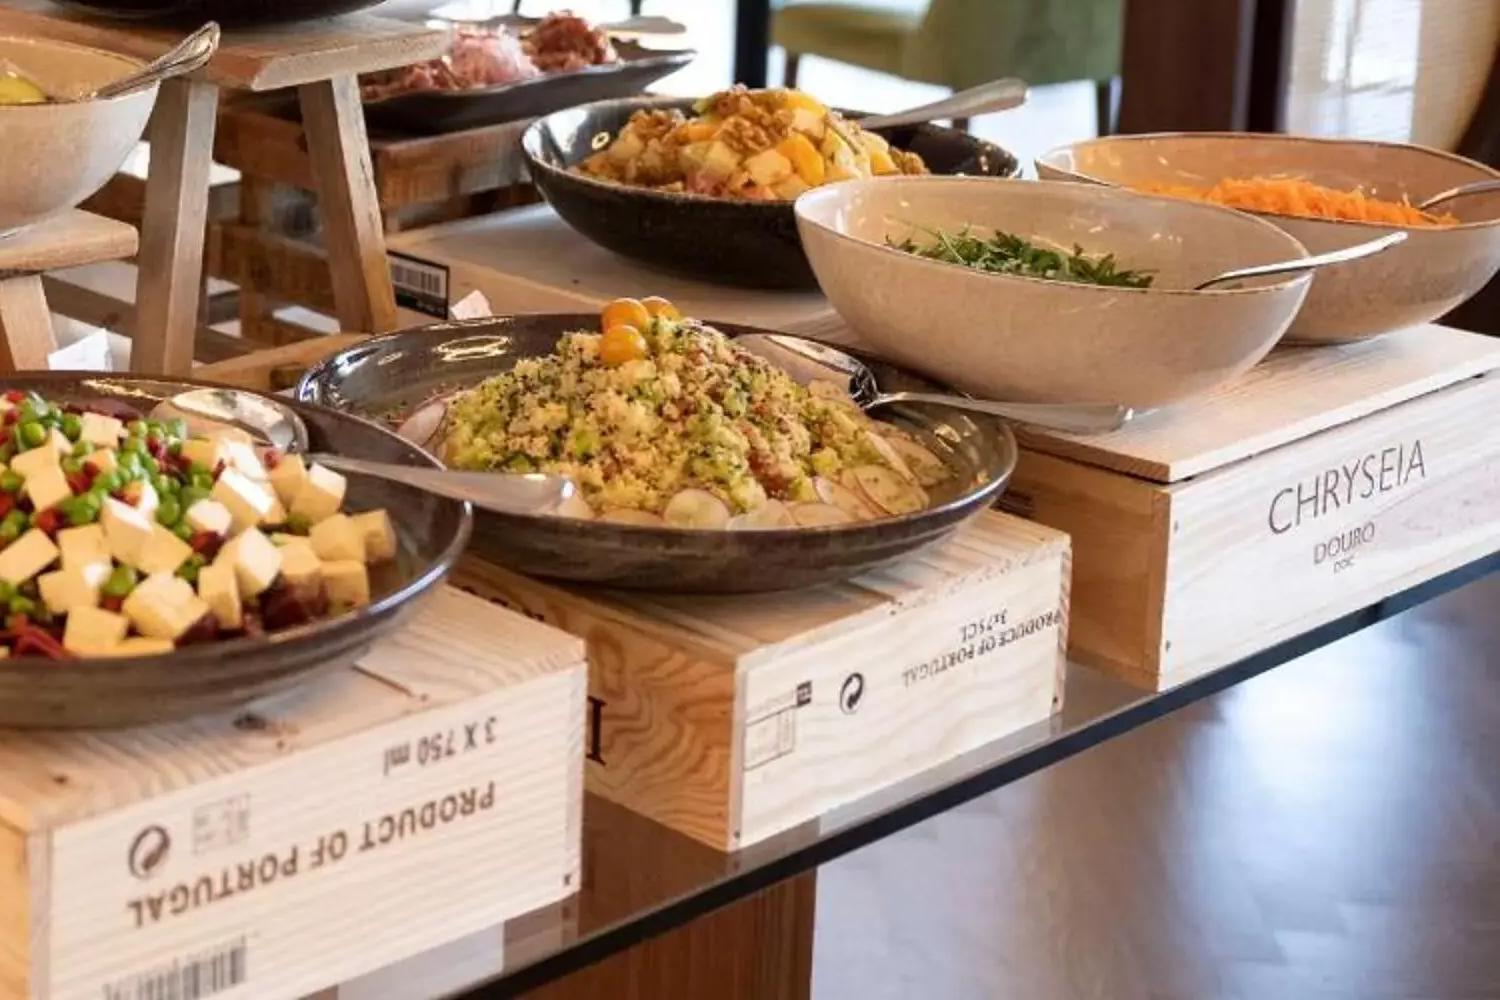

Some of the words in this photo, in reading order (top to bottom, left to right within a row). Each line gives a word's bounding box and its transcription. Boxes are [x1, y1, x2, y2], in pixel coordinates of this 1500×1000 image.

[1268, 439, 1426, 535] CHRYSEIA
[1313, 521, 1376, 566] DOURO
[977, 634, 997, 657] OF
[998, 608, 1062, 647] PRODUCE
[901, 643, 975, 689] PORTUGAL
[483, 716, 498, 744] 3
[382, 744, 412, 777] ml
[416, 733, 457, 767] 750
[358, 781, 497, 851] PRODUCT
[309, 834, 349, 872] OF
[127, 847, 299, 928] PORTUGAL
